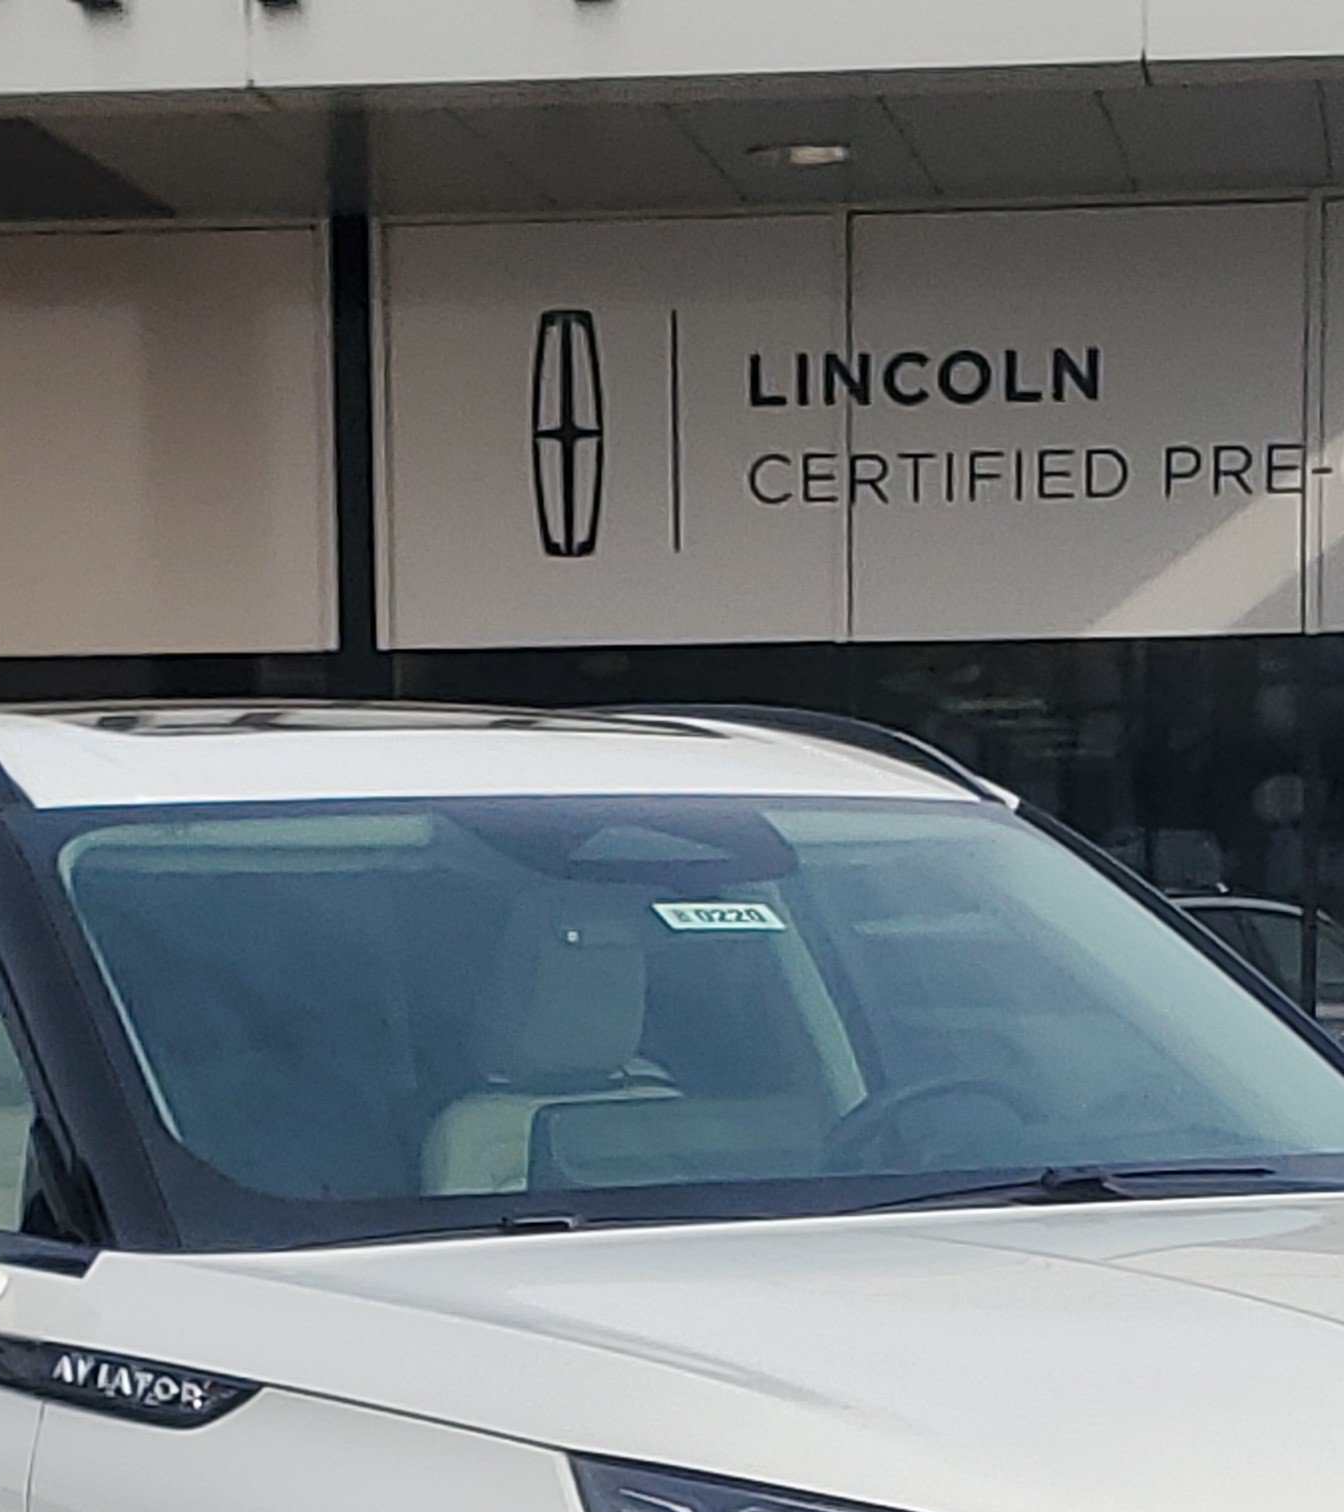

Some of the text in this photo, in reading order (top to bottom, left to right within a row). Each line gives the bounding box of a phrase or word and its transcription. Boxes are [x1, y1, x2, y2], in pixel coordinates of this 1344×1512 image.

[747, 346, 1102, 408] LINCOLN
[747, 447, 1130, 506] CERTIFIED
[694, 908, 768, 923] 0220
